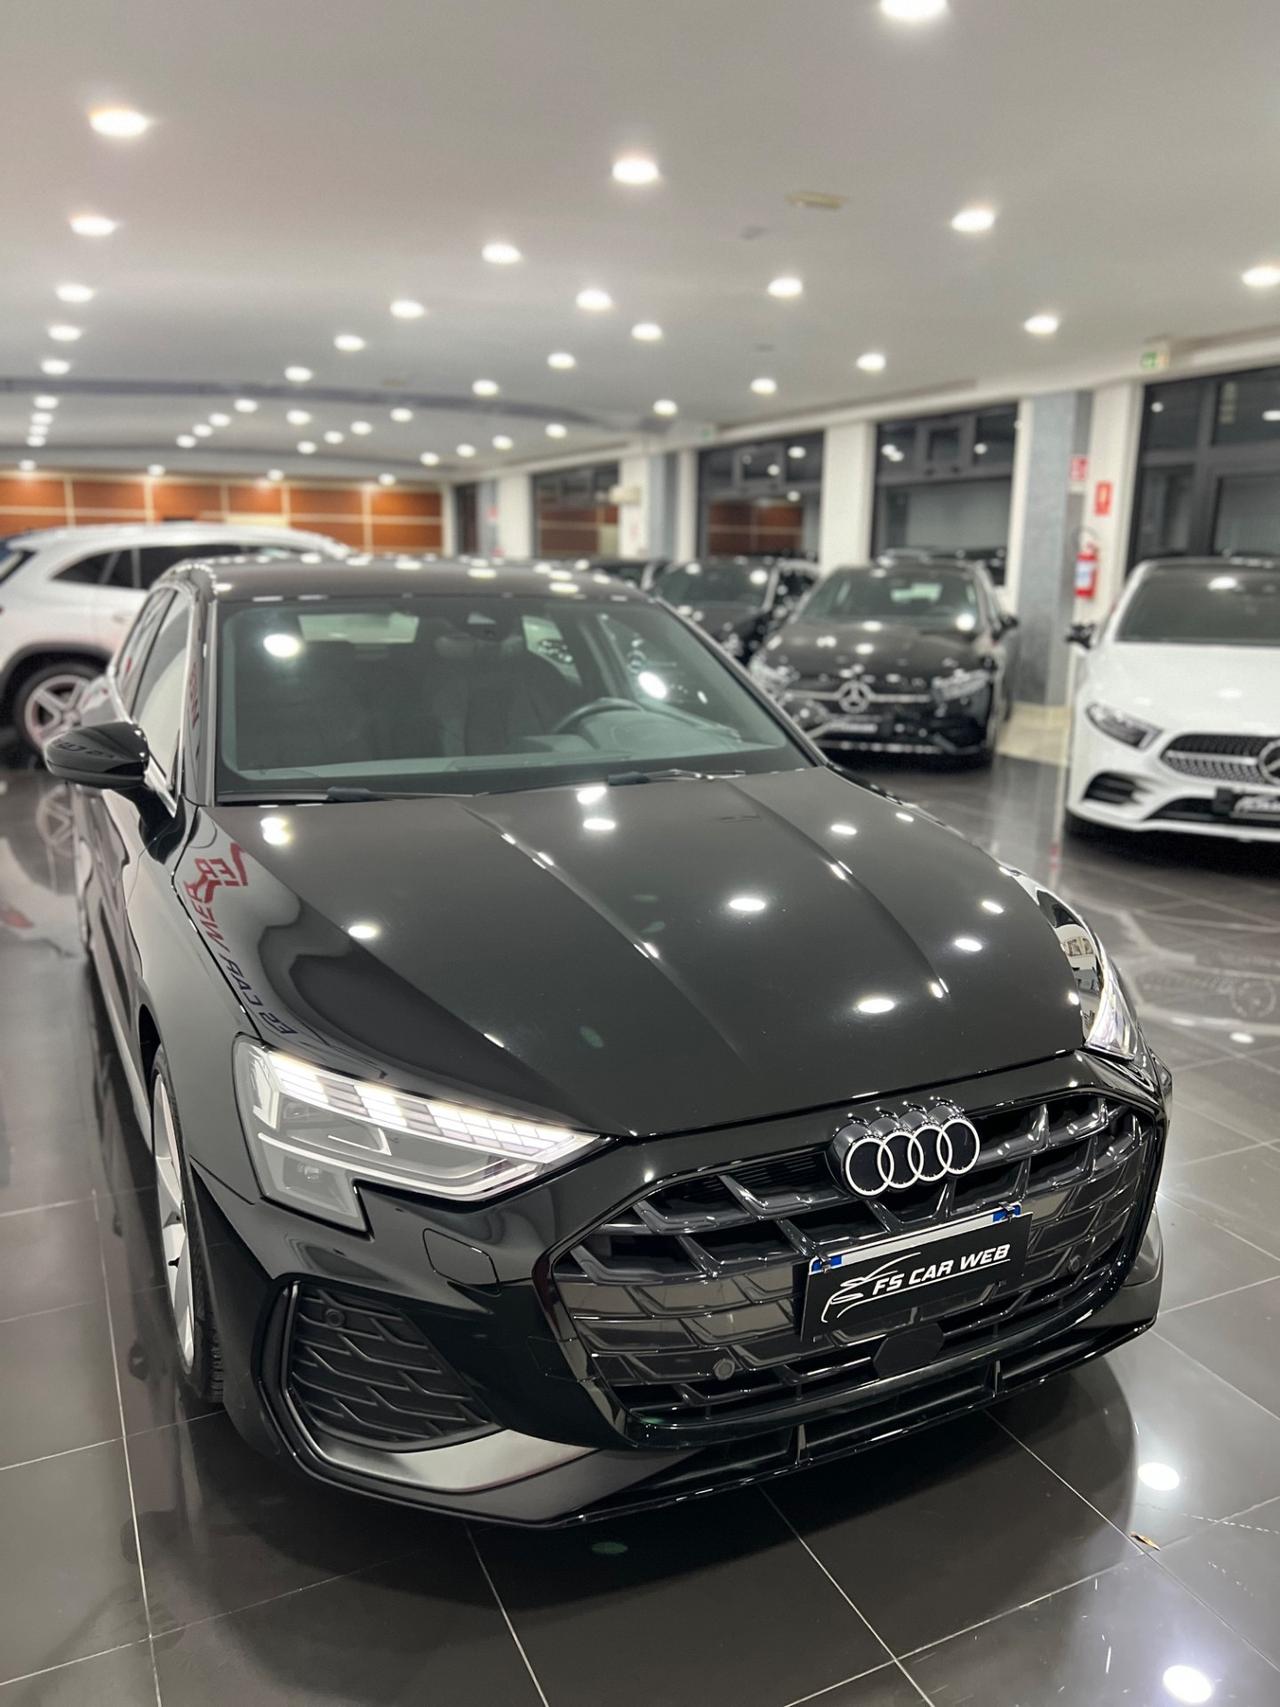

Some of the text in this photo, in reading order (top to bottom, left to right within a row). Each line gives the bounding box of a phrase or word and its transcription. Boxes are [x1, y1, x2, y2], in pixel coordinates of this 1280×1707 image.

[872, 1243, 1011, 1296] FS CAR WEB
